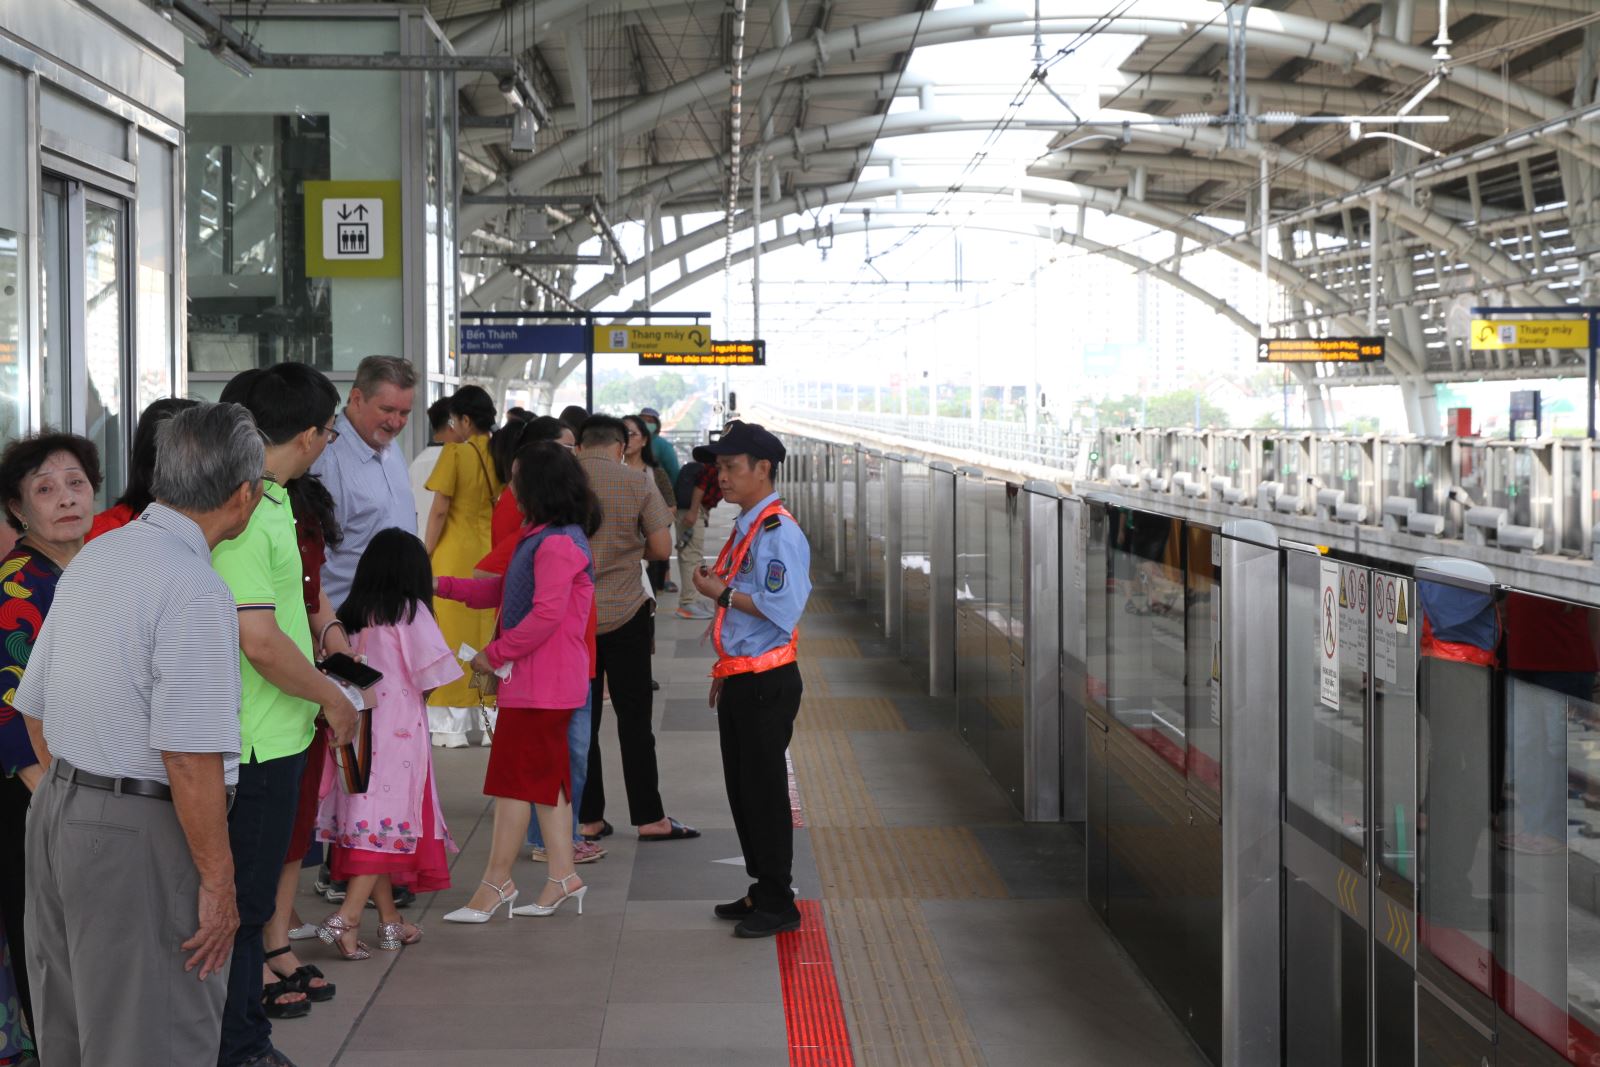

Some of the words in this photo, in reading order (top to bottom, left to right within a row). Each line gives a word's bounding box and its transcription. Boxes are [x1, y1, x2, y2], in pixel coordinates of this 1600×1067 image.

[466, 328, 485, 339] Bến
[488, 328, 518, 339] Thành
[632, 329, 661, 341] Thang
[1520, 324, 1549, 336] Thang
[758, 347, 763, 359] 1
[1259, 343, 1268, 357] 2
